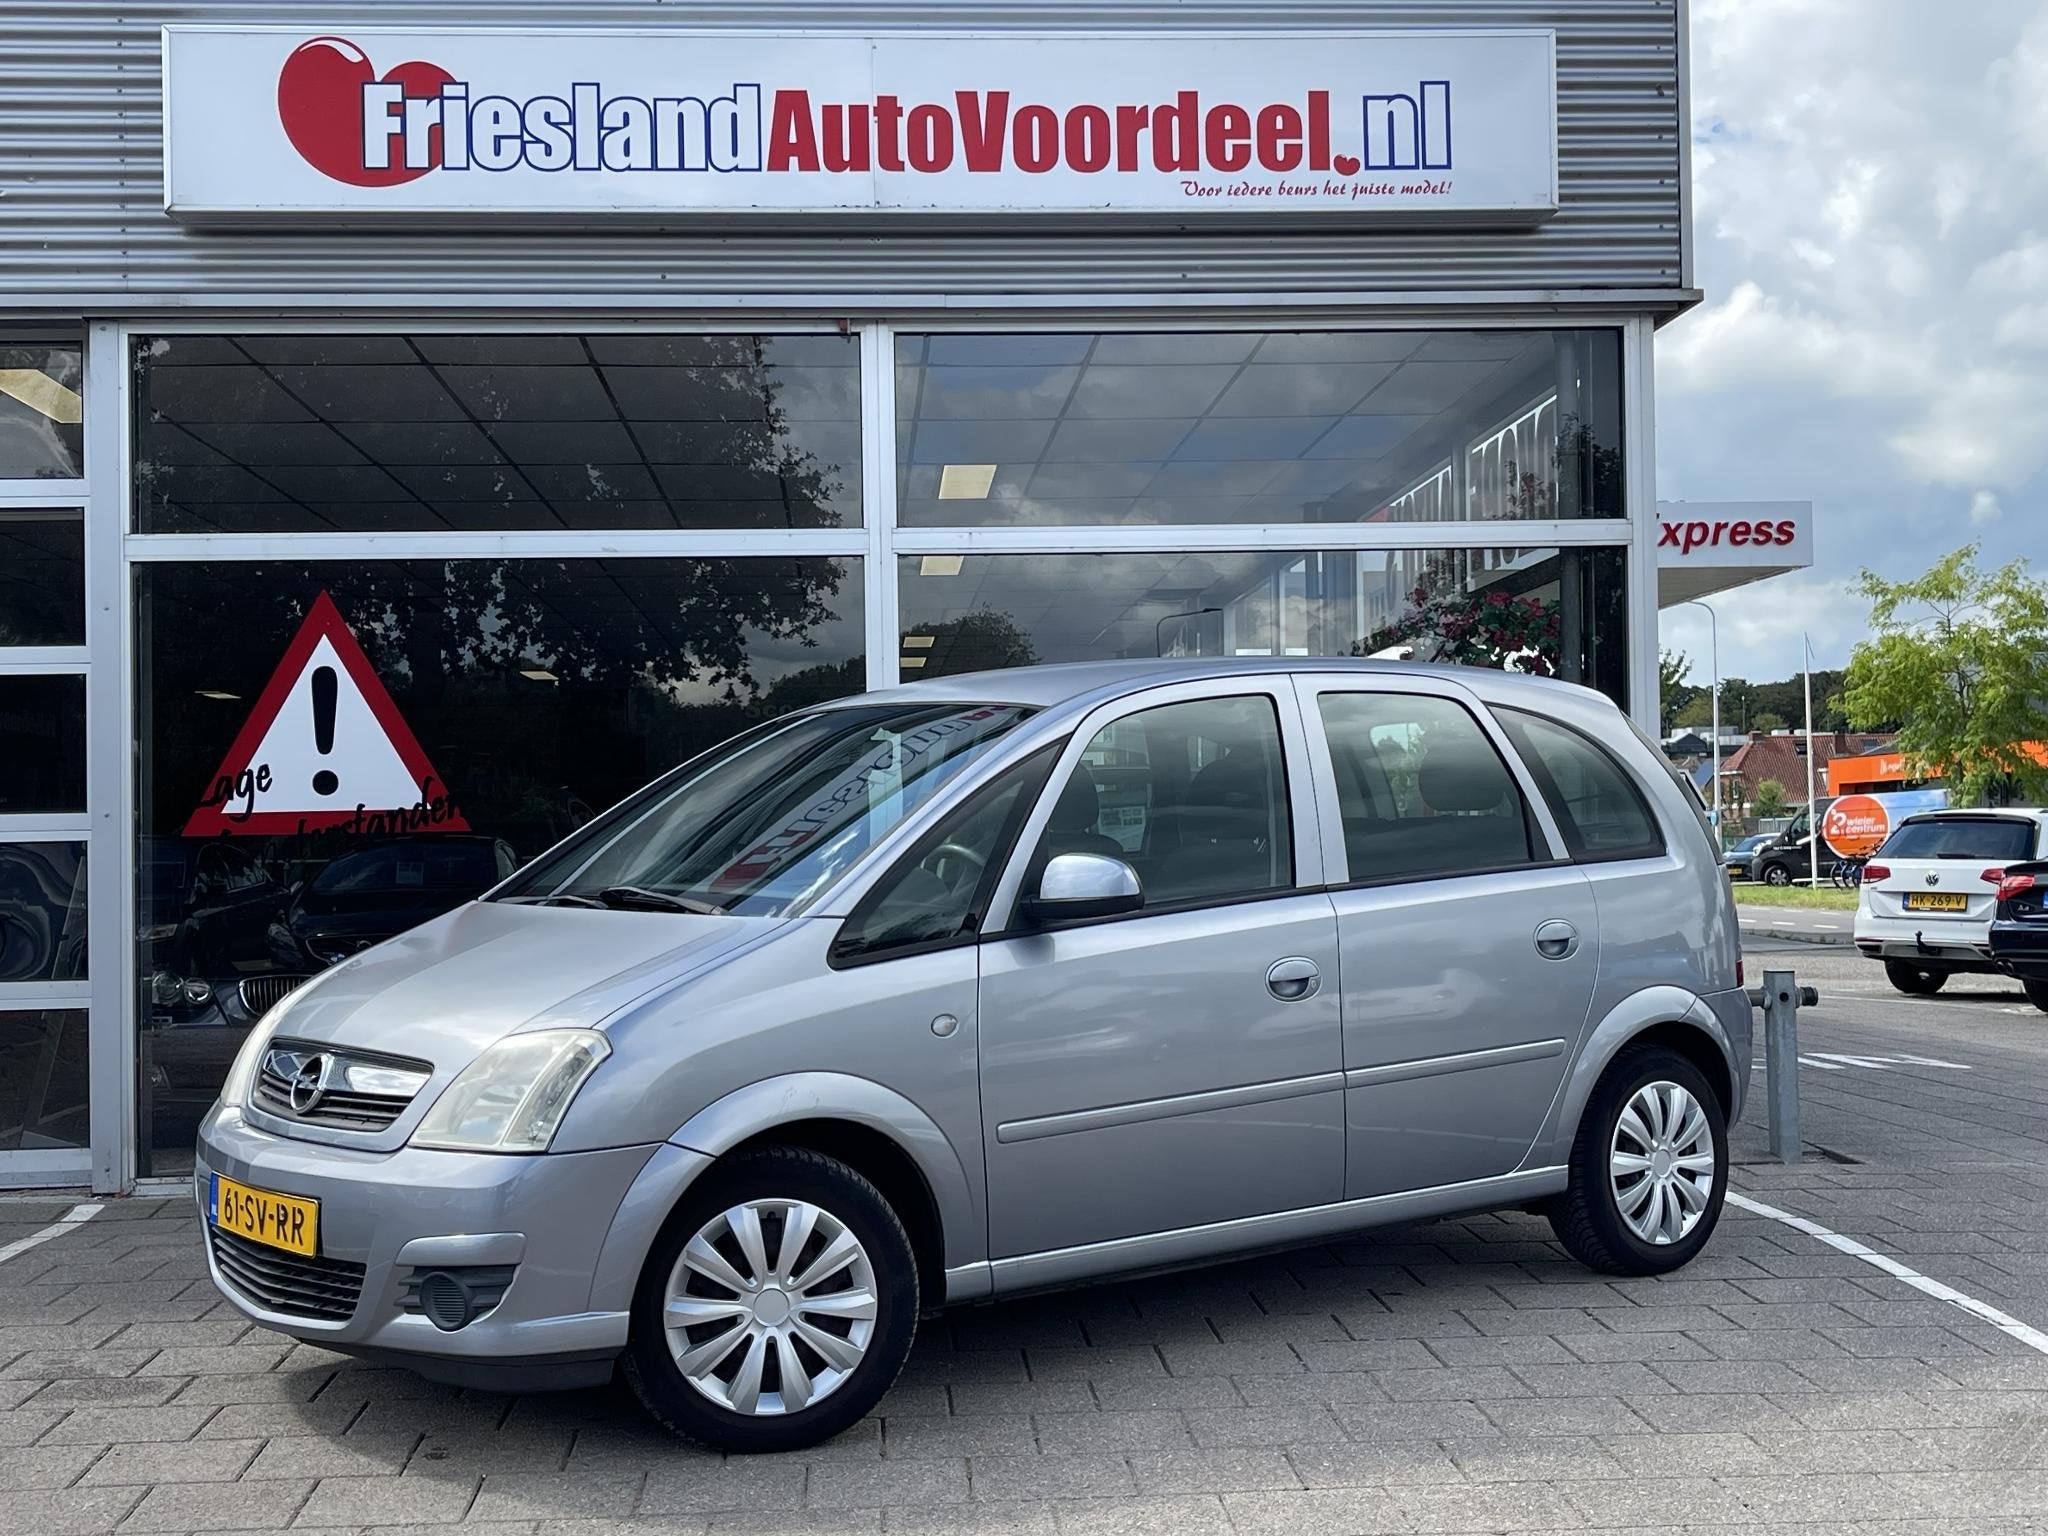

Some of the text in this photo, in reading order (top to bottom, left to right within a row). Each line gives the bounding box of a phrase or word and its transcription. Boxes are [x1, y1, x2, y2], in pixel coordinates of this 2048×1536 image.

[1180, 180, 1453, 200] Voor iedere beurs het juiste model!
[1656, 512, 1796, 556] xpress
[224, 1187, 305, 1247] 61-SV-RR
